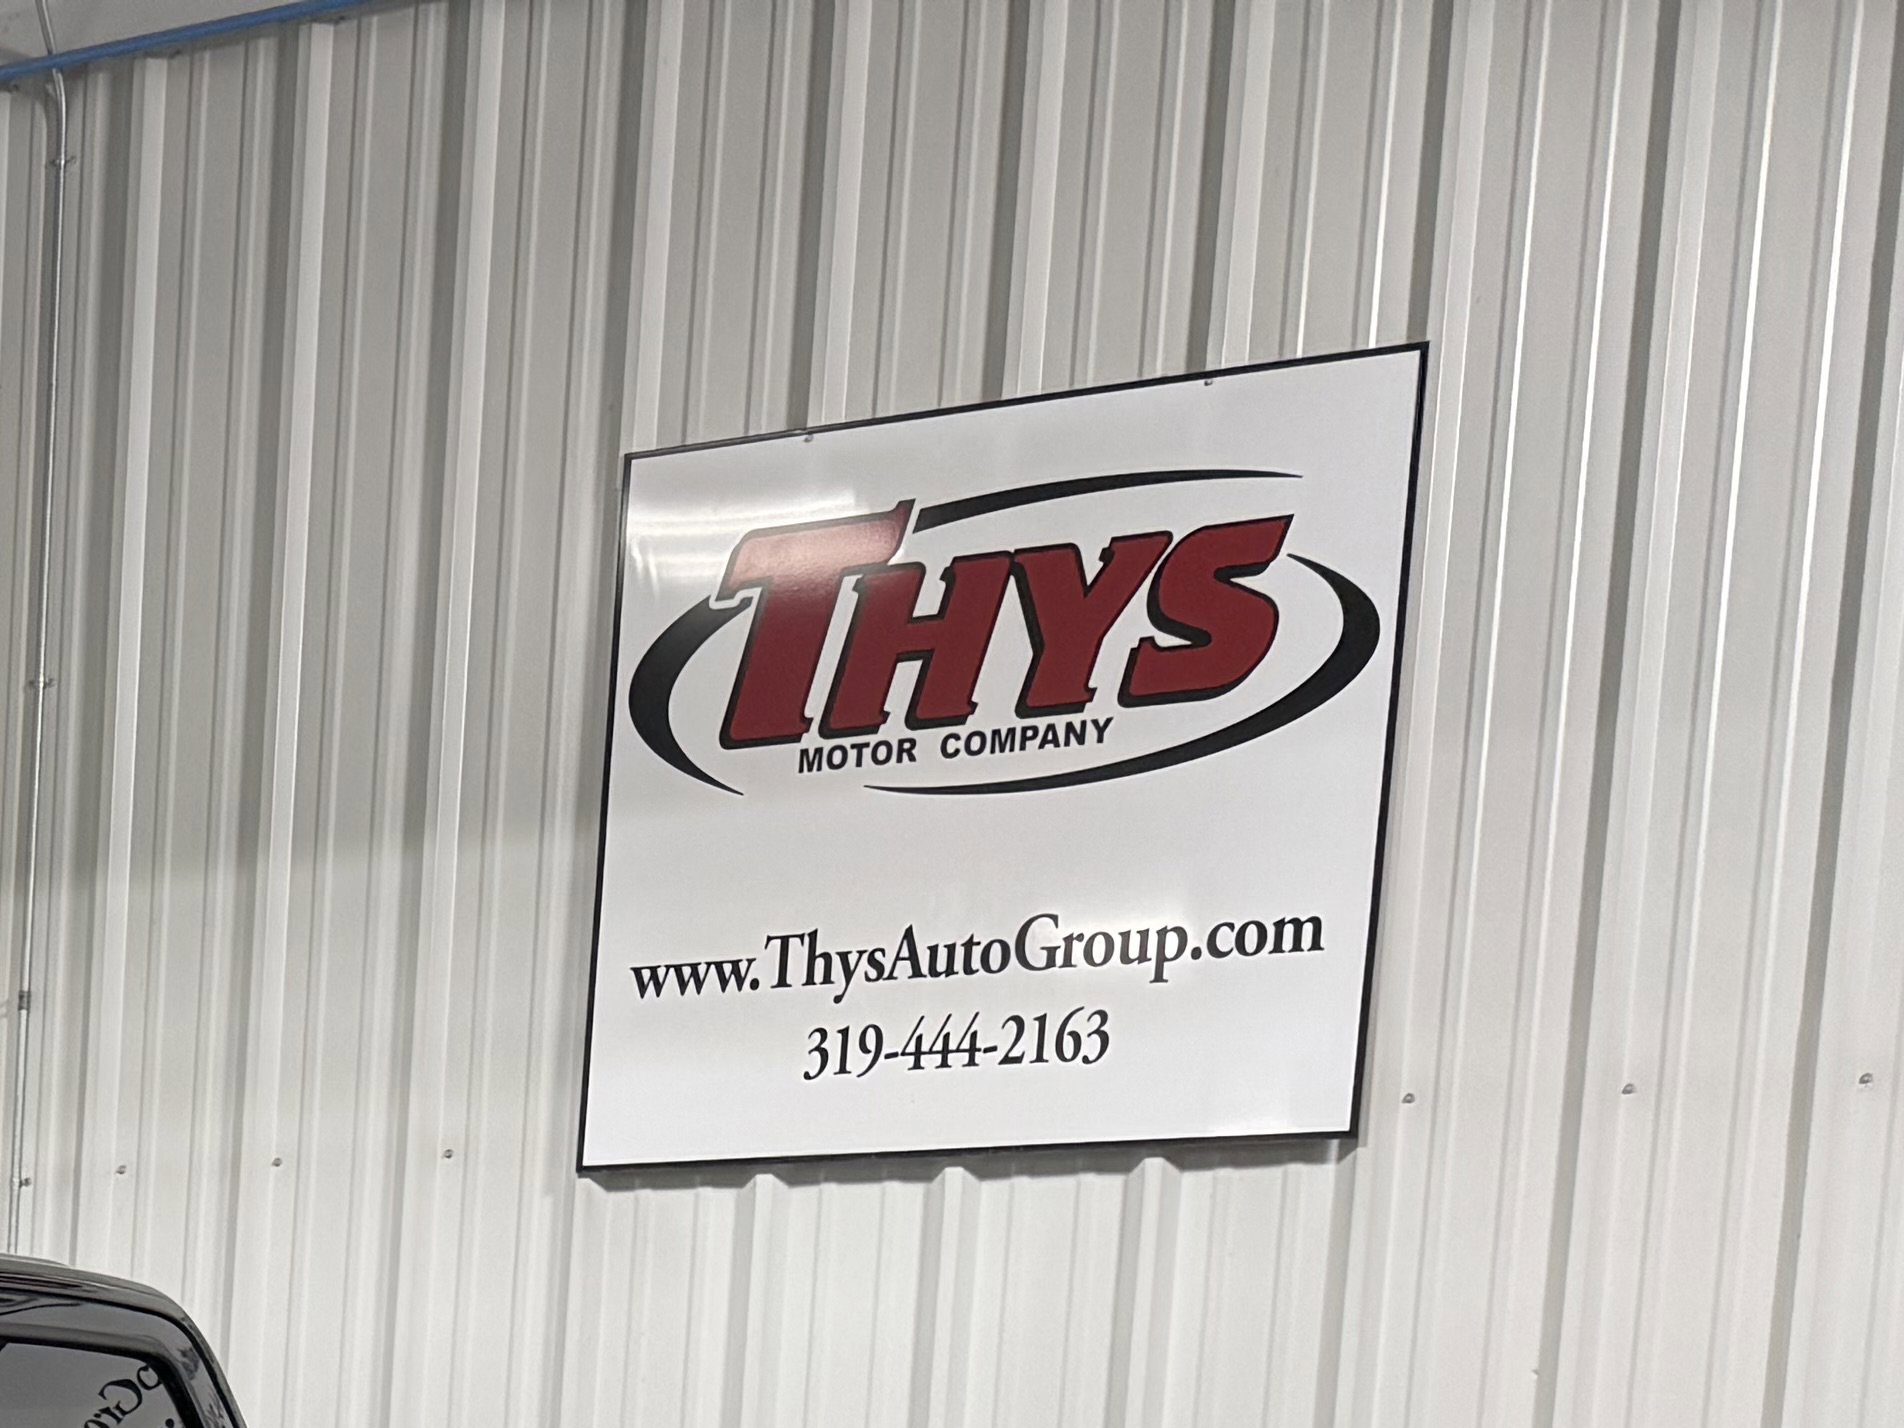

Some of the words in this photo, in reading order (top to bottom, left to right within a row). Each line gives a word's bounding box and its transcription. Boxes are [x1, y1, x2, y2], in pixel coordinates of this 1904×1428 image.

[718, 499, 1295, 751] THYS
[797, 736, 917, 774] MOTOR
[940, 717, 1114, 762] COMPANY
[630, 913, 1324, 1004] www.ThysAutoGroup.com
[803, 1007, 1110, 1082] 319-444-2163
